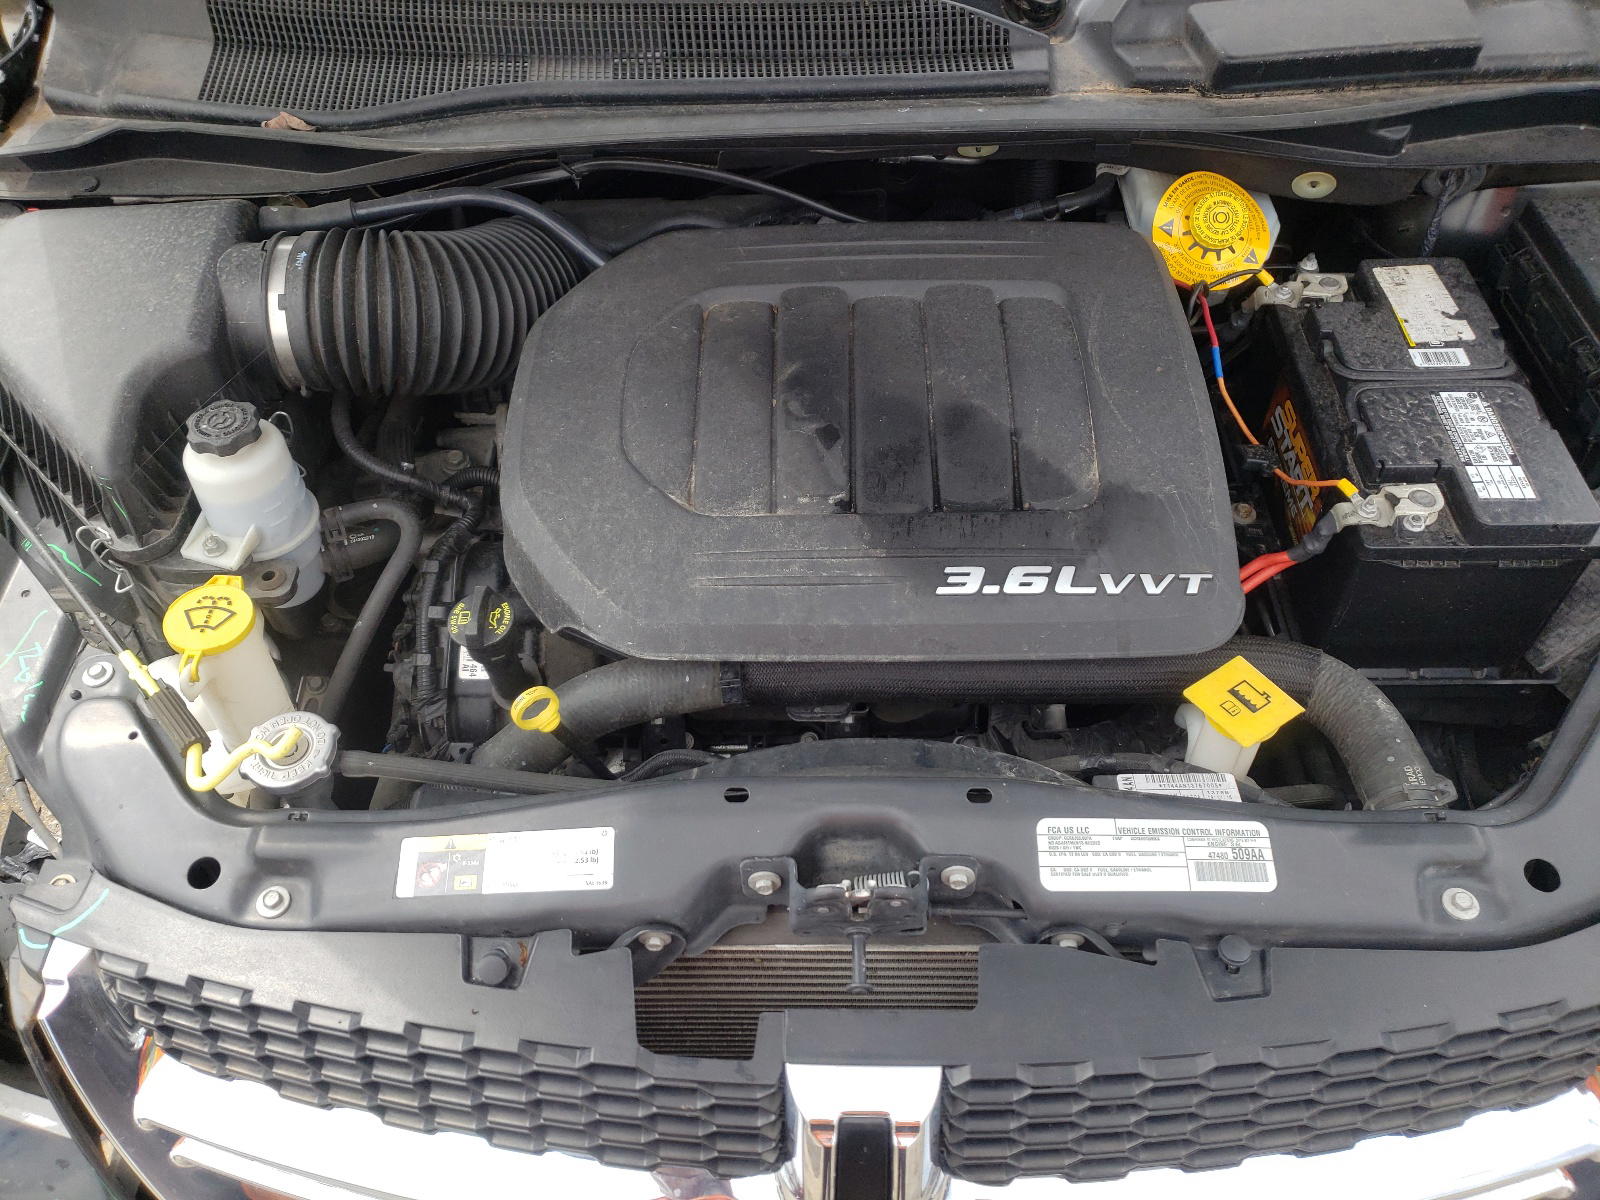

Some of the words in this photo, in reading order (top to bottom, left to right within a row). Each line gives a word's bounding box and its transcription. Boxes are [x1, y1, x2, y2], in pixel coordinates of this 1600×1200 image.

[936, 566, 1097, 594] 3.6L
[1100, 574, 1213, 594] VVT
[501, 602, 512, 625] ENGINE
[494, 625, 506, 635] OIL
[1047, 826, 1061, 834] FCA
[1063, 826, 1074, 834] US
[1076, 826, 1090, 834] LLC
[1118, 827, 1146, 835] VEHICLE
[1182, 828, 1213, 836] CONTROL
[1215, 829, 1261, 837] INFORMATION
[1231, 848, 1265, 860] 509AA
